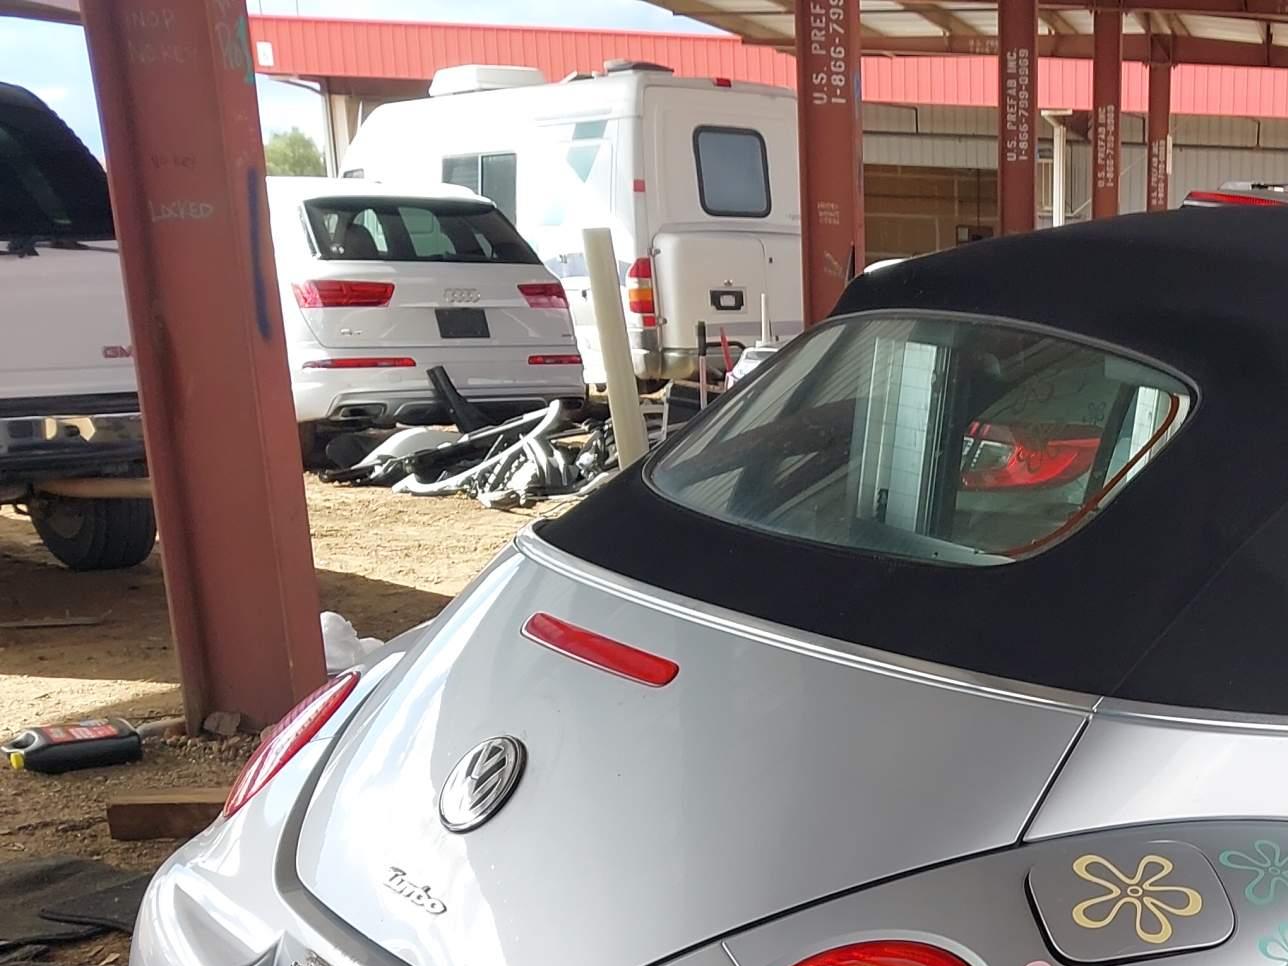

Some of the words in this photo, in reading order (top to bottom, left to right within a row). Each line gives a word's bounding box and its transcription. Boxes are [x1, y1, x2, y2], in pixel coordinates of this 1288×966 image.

[810, 3, 827, 55] PREF
[811, 66, 828, 105] U.S.
[1006, 79, 1017, 130] PREFAB
[1018, 48, 1029, 161] 1-866-799-0969
[1006, 136, 1017, 162] U.S.
[148, 199, 216, 223] LOCKED
[103, 346, 134, 359] GM
[384, 866, 447, 916] Turbo
